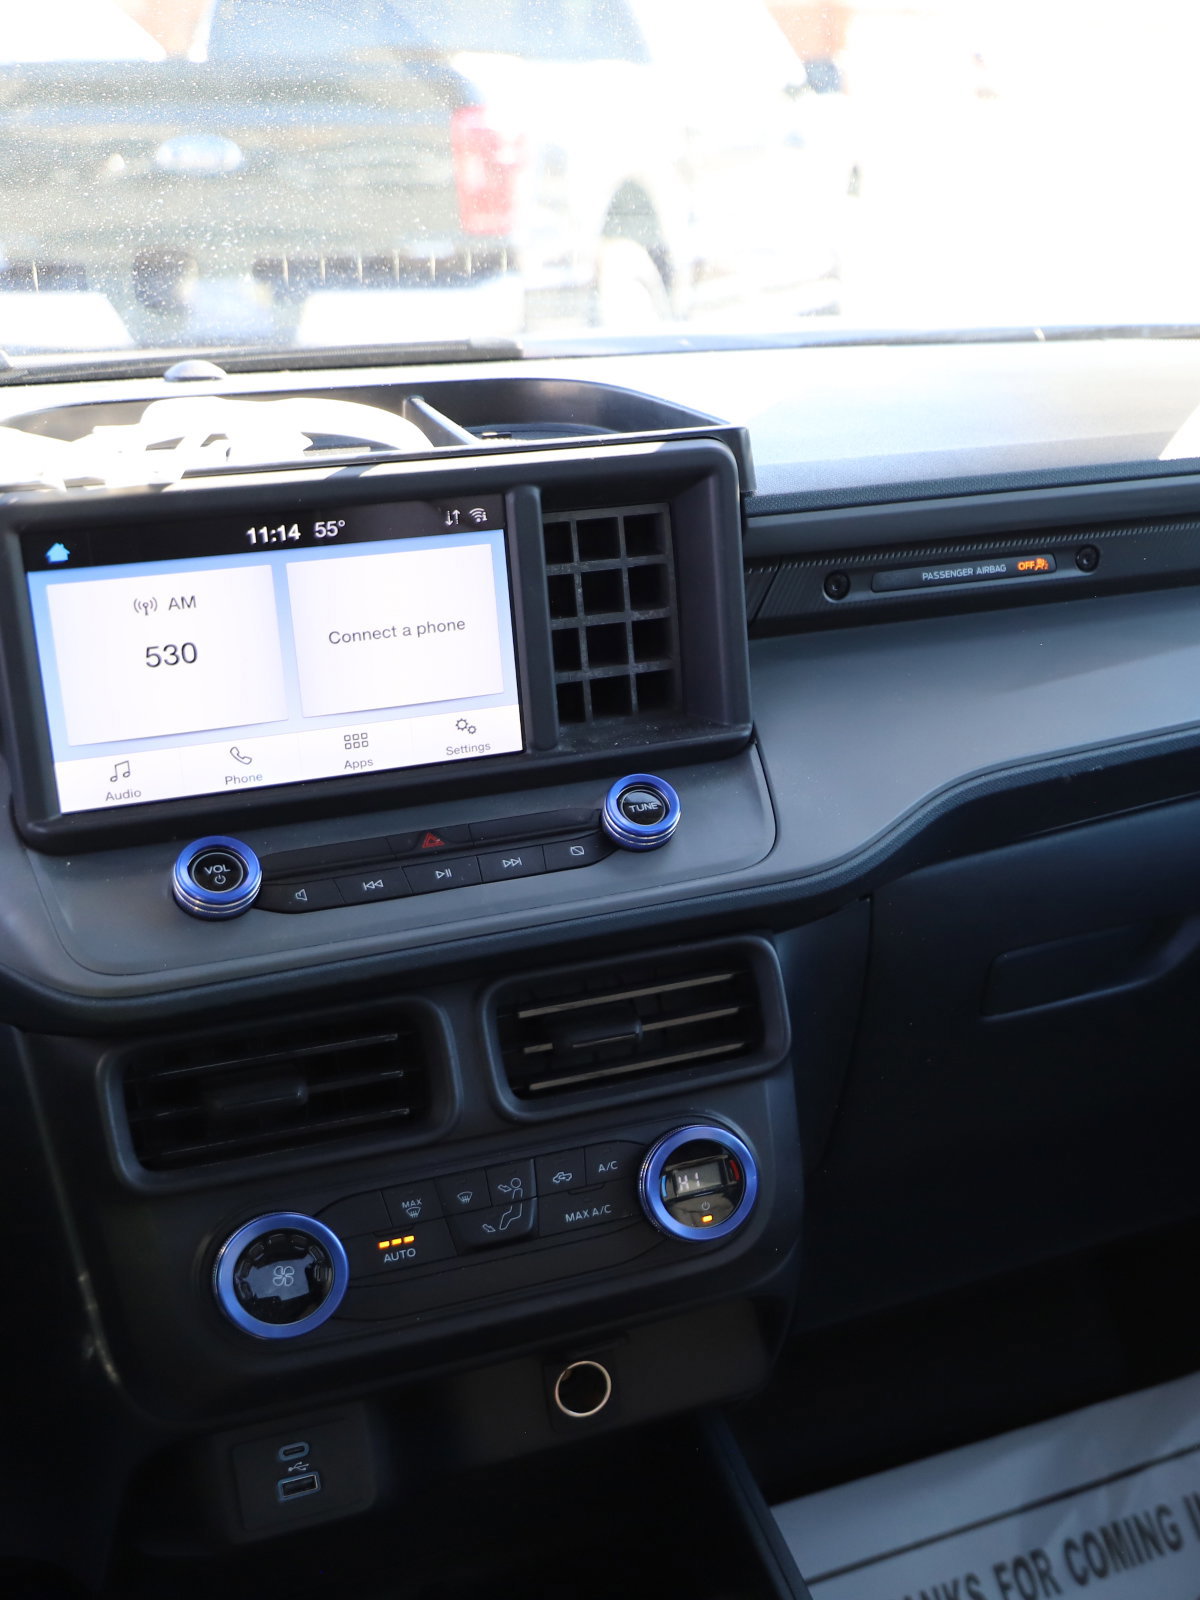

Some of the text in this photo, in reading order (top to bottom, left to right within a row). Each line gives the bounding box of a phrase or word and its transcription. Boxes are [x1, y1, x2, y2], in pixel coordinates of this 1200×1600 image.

[246, 520, 345, 545] 11:14 55°
[922, 560, 1035, 581] PASSENGER AIRBAG OFF
[168, 595, 196, 611] AM
[328, 620, 466, 644] Connect a phone
[145, 642, 198, 668] 530
[446, 742, 491, 757] Settings
[343, 758, 374, 771] Apps
[224, 773, 263, 786] Phone
[104, 788, 142, 801] Audio
[629, 802, 659, 812] TUNE
[204, 864, 231, 874] VOL
[598, 1160, 618, 1173] A/C
[402, 1198, 422, 1209] MAX
[565, 1204, 612, 1223] MAX A/C
[383, 1248, 416, 1263] AUTO
[992, 1547, 1064, 1600] FOR
[1062, 1503, 1184, 1587] COMING
